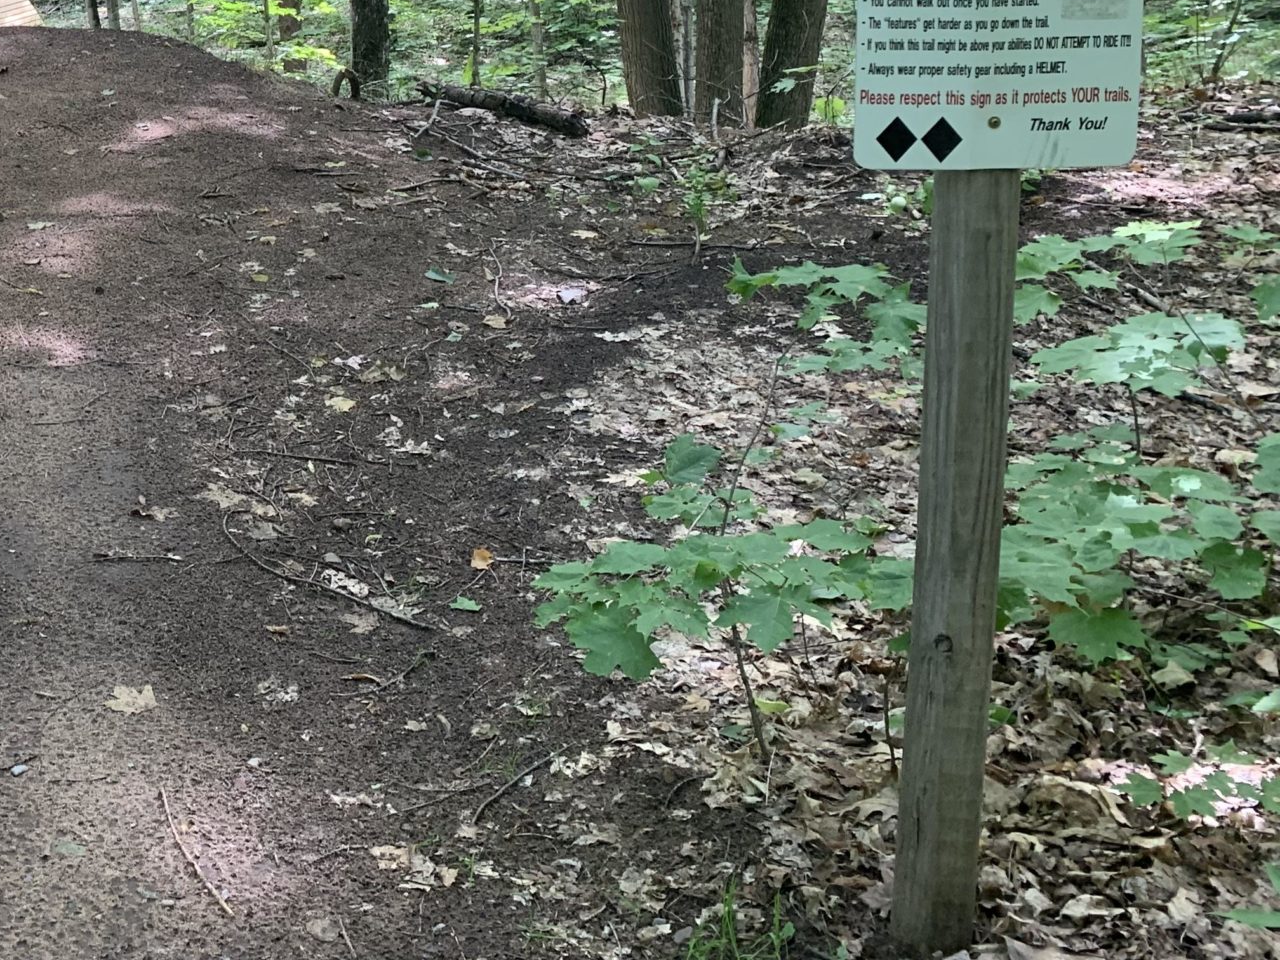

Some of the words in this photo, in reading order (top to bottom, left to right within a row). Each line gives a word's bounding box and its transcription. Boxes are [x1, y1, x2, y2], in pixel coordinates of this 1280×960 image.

[869, 17, 881, 29] The
[923, 18, 935, 32] get
[938, 17, 961, 29] harder
[964, 20, 972, 30] as
[976, 20, 987, 32] you
[991, 20, 999, 32] go
[1002, 17, 1019, 29] down
[1022, 17, 1033, 28] the
[1036, 16, 1049, 28] trail.
[867, 39, 872, 50] If
[875, 42, 886, 52] you
[889, 39, 904, 50] think
[908, 39, 919, 51] this
[923, 40, 934, 51] trail
[937, 40, 956, 53] might
[959, 40, 967, 51] be
[970, 40, 989, 51] above
[992, 41, 1005, 53] your
[1008, 39, 1031, 50] abilities
[1034, 37, 1043, 49] DO
[1046, 37, 1059, 49] NOT
[1061, 36, 1090, 49] ATTEMPT
[1092, 35, 1101, 48] TO
[1103, 35, 1118, 47] RIDE
[868, 63, 894, 77] Always
[898, 66, 915, 75] wear
[919, 65, 944, 77] proper
[947, 64, 971, 78] safety
[975, 65, 991, 78] gear
[994, 63, 1025, 77] including
[1029, 65, 1033, 74] a
[1036, 61, 1067, 74] HELMET.
[860, 90, 895, 105] Please
[900, 91, 941, 108] respect
[946, 91, 965, 105] this
[970, 91, 991, 108] sign
[995, 93, 1007, 104] as
[1012, 89, 1018, 104] it
[1023, 90, 1066, 107] protects
[1072, 87, 1100, 102] YOUR
[1105, 87, 1131, 102] trails.
[1030, 118, 1071, 131] Thank
[1079, 117, 1108, 130] You!
